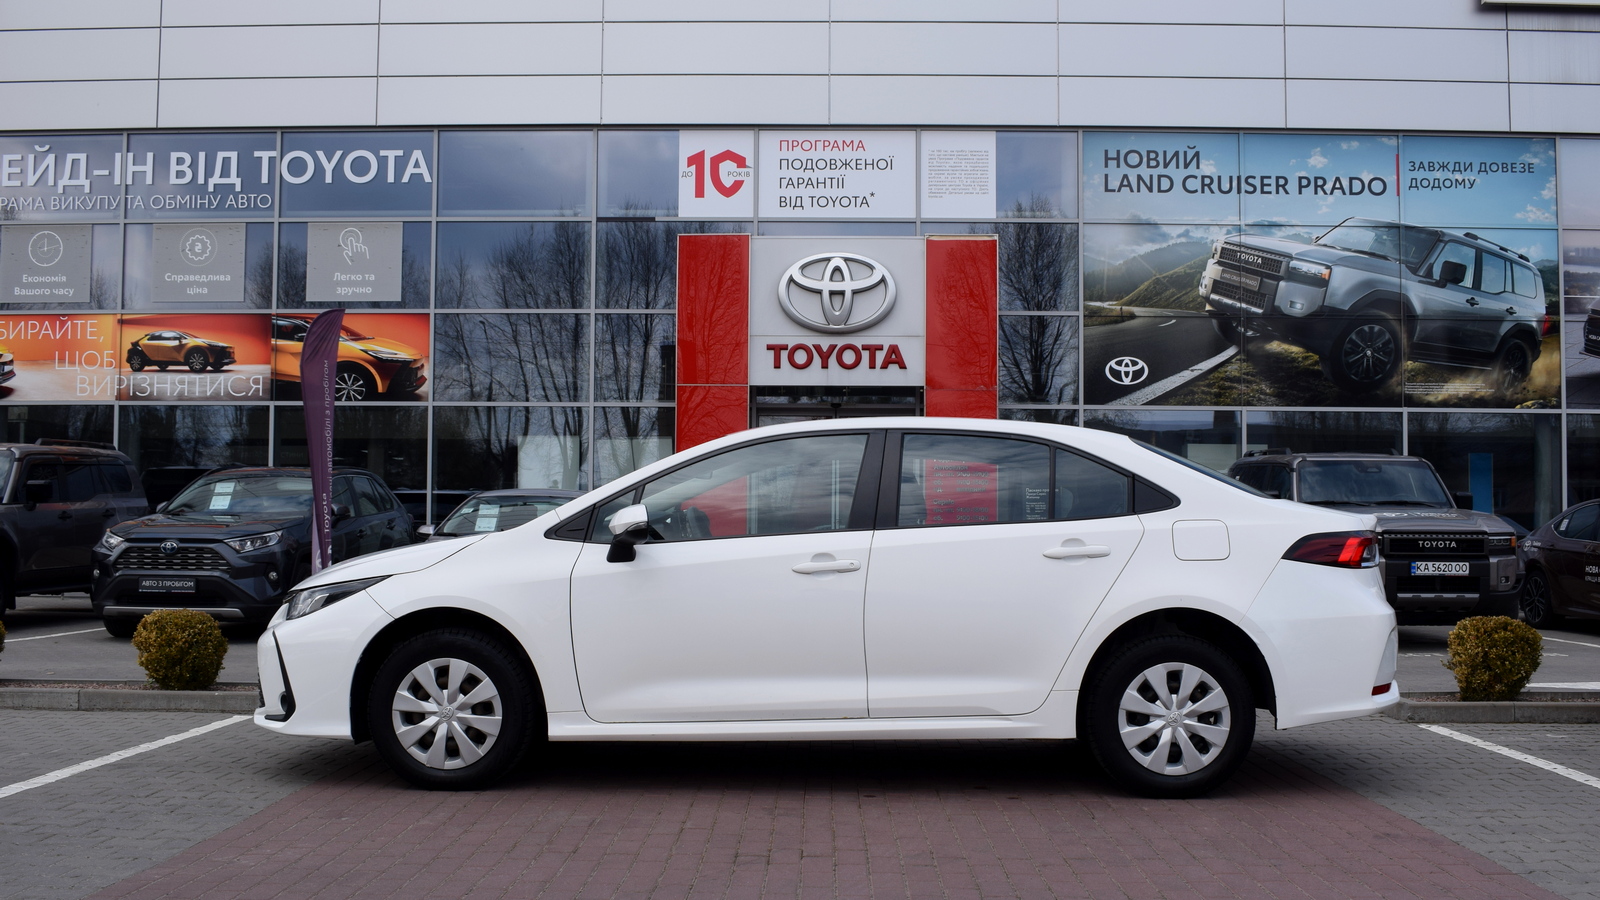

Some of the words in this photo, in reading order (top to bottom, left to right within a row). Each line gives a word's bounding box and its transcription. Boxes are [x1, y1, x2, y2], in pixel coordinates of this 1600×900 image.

[779, 139, 866, 152] ПРОГРАМА
[778, 156, 895, 173] ПОДОВЖЕНОЇ
[1103, 145, 1202, 170] НОВИЙ
[169, 150, 242, 192] ВІД
[254, 150, 432, 185] TOYOTA
[682, 171, 694, 179] ДО
[1408, 160, 1474, 176] ЗАВЖДИ
[1477, 162, 1536, 176] ДОВЕЗЕ
[778, 174, 846, 190] ГАРАНТІЇ
[1103, 174, 1175, 194] LAND
[1181, 174, 1290, 196] CRUISER
[1298, 176, 1388, 197] PRADO
[1408, 177, 1476, 192] ДОДОМУ
[0, 196, 45, 210] РАМА
[51, 195, 121, 211] ВИКУПУ
[126, 194, 145, 210] ТА
[151, 194, 222, 210] ОБМІНУ
[225, 194, 272, 209] АВТО
[778, 196, 805, 210] ВІД
[1237, 252, 1261, 263] TOYOTA
[22, 274, 67, 283] Економія
[164, 273, 231, 283] Справедлива
[333, 272, 362, 281] Легко
[14, 286, 51, 296] Вашого
[53, 288, 74, 296] часу
[186, 285, 208, 295] ціна
[336, 286, 372, 296] зручно
[55, 350, 116, 374] ЩОБ
[766, 342, 908, 370] TOYOTA
[76, 374, 264, 397] ВИРІЗНЯТИСЯ
[322, 359, 331, 408] пробігом
[324, 418, 333, 474] автомобілі
[322, 492, 331, 534] Toyota
[1417, 563, 1429, 572] KA
[1432, 563, 1452, 572] 5620
